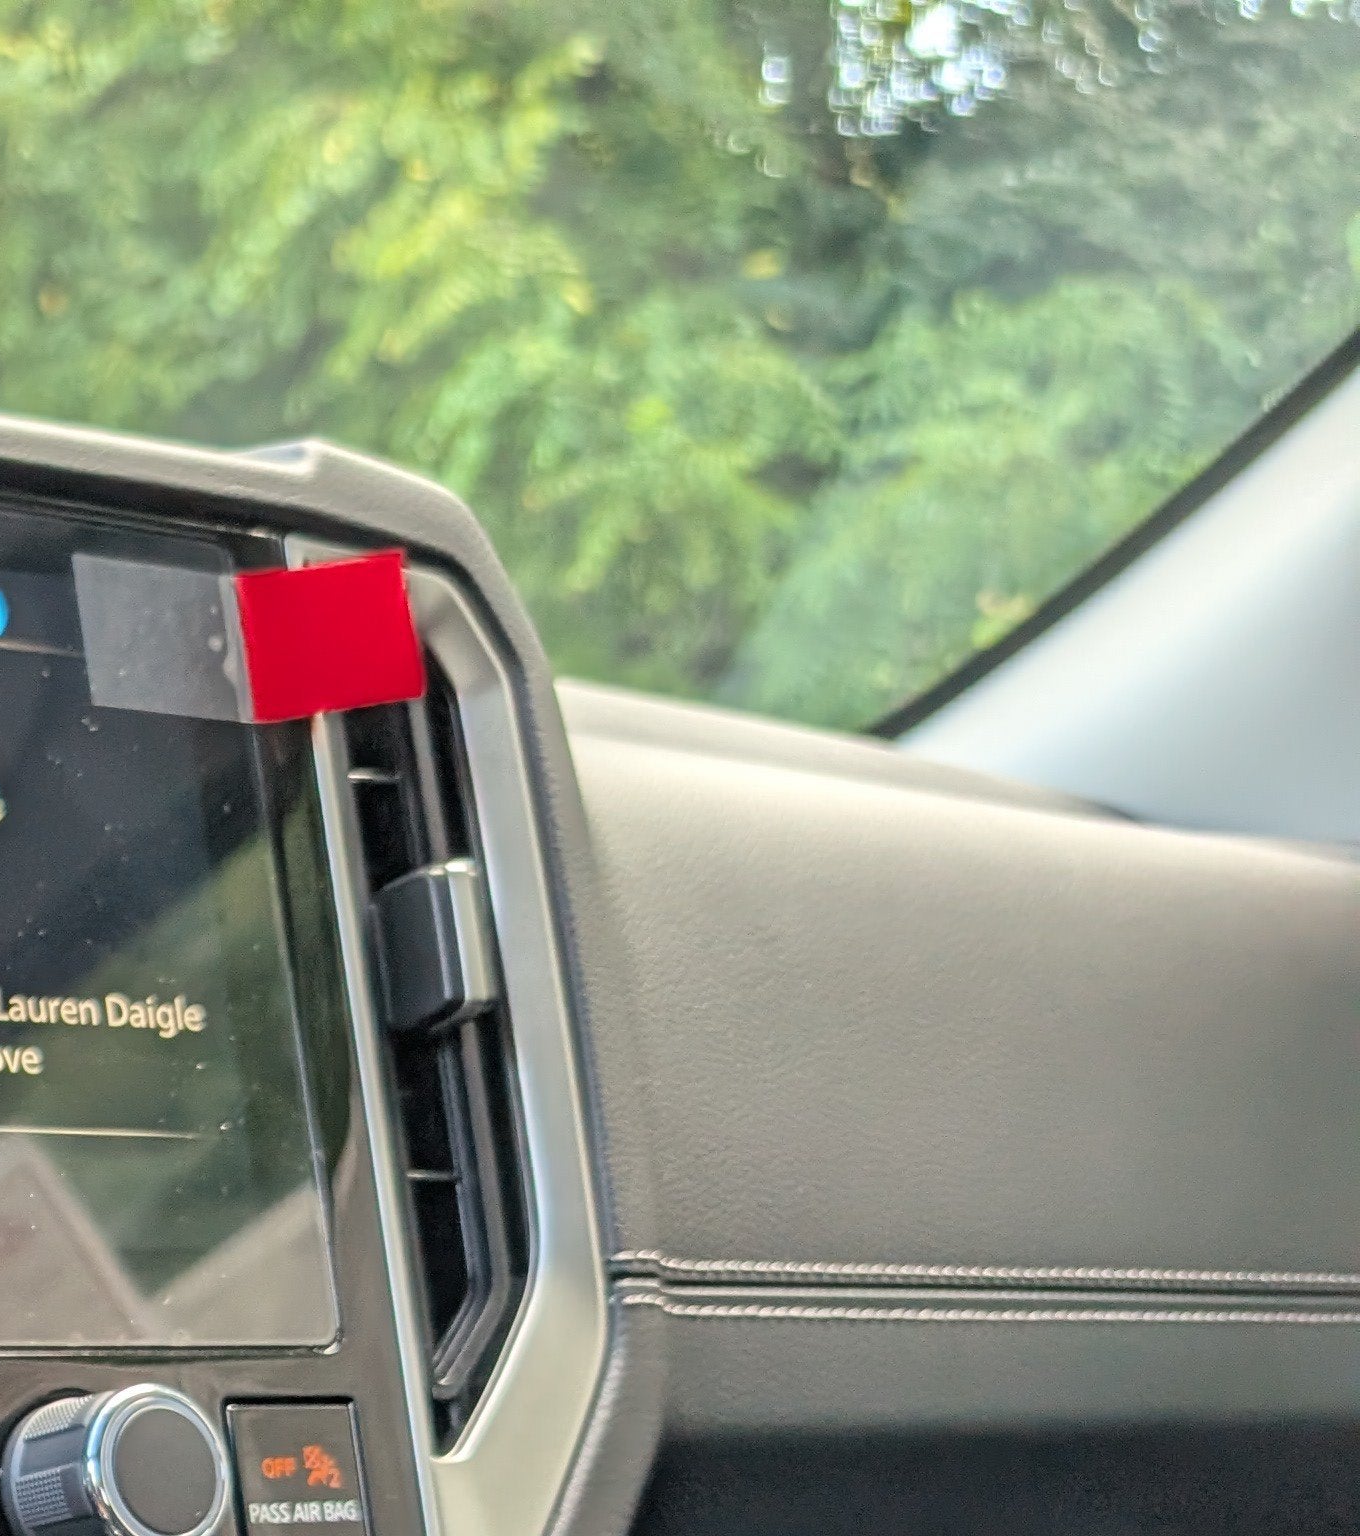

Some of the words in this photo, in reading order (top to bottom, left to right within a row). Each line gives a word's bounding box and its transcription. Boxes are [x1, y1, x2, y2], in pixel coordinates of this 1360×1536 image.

[107, 993, 207, 1039] Daigle
[261, 1455, 298, 1480] OFF
[248, 1502, 291, 1524] PASS
[293, 1501, 322, 1522] AIR
[323, 1499, 360, 1522] BAG
